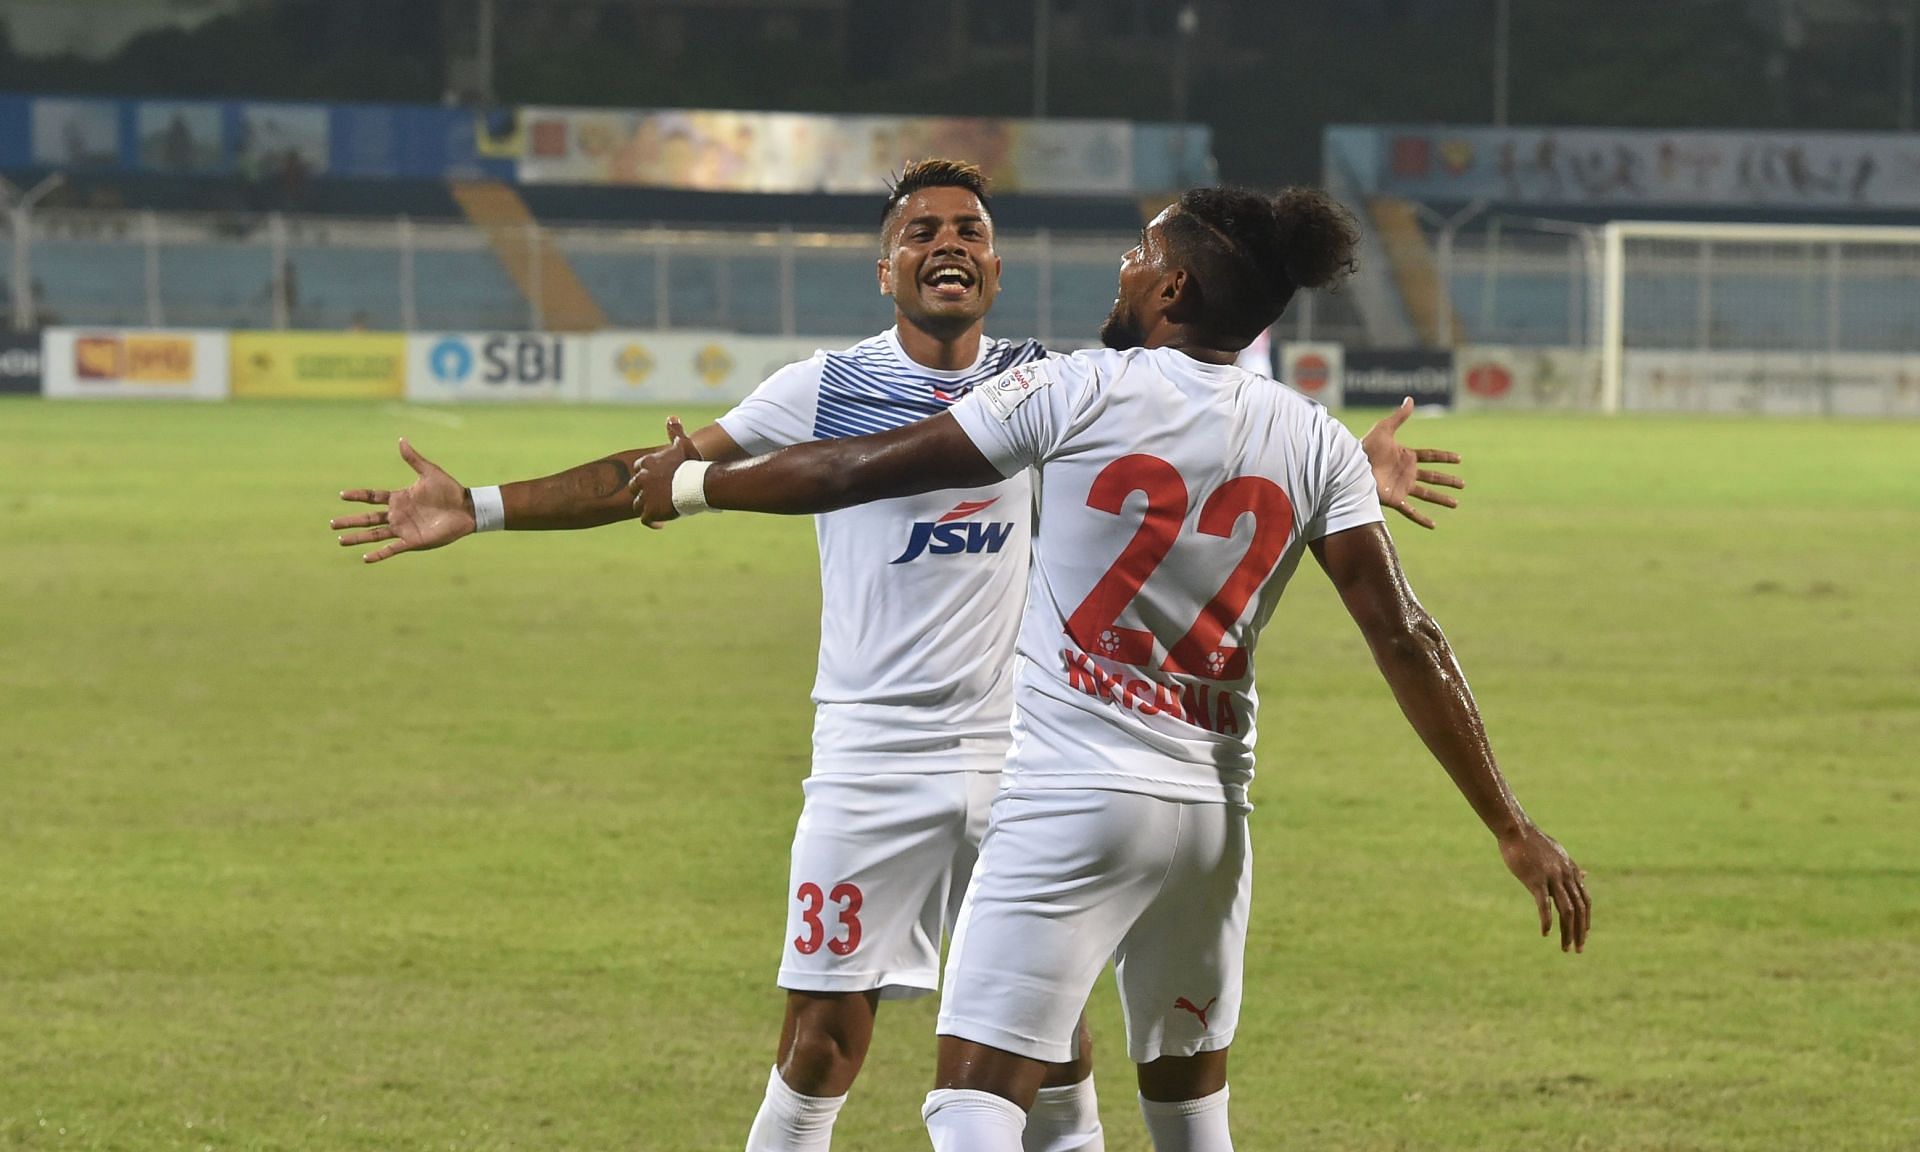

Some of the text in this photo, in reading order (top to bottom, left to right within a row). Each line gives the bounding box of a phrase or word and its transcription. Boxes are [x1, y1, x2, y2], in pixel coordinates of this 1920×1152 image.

[483, 336, 564, 384] SBI
[888, 522, 1015, 564] JSW
[1063, 453, 1294, 680] 22
[794, 882, 864, 956] 33
